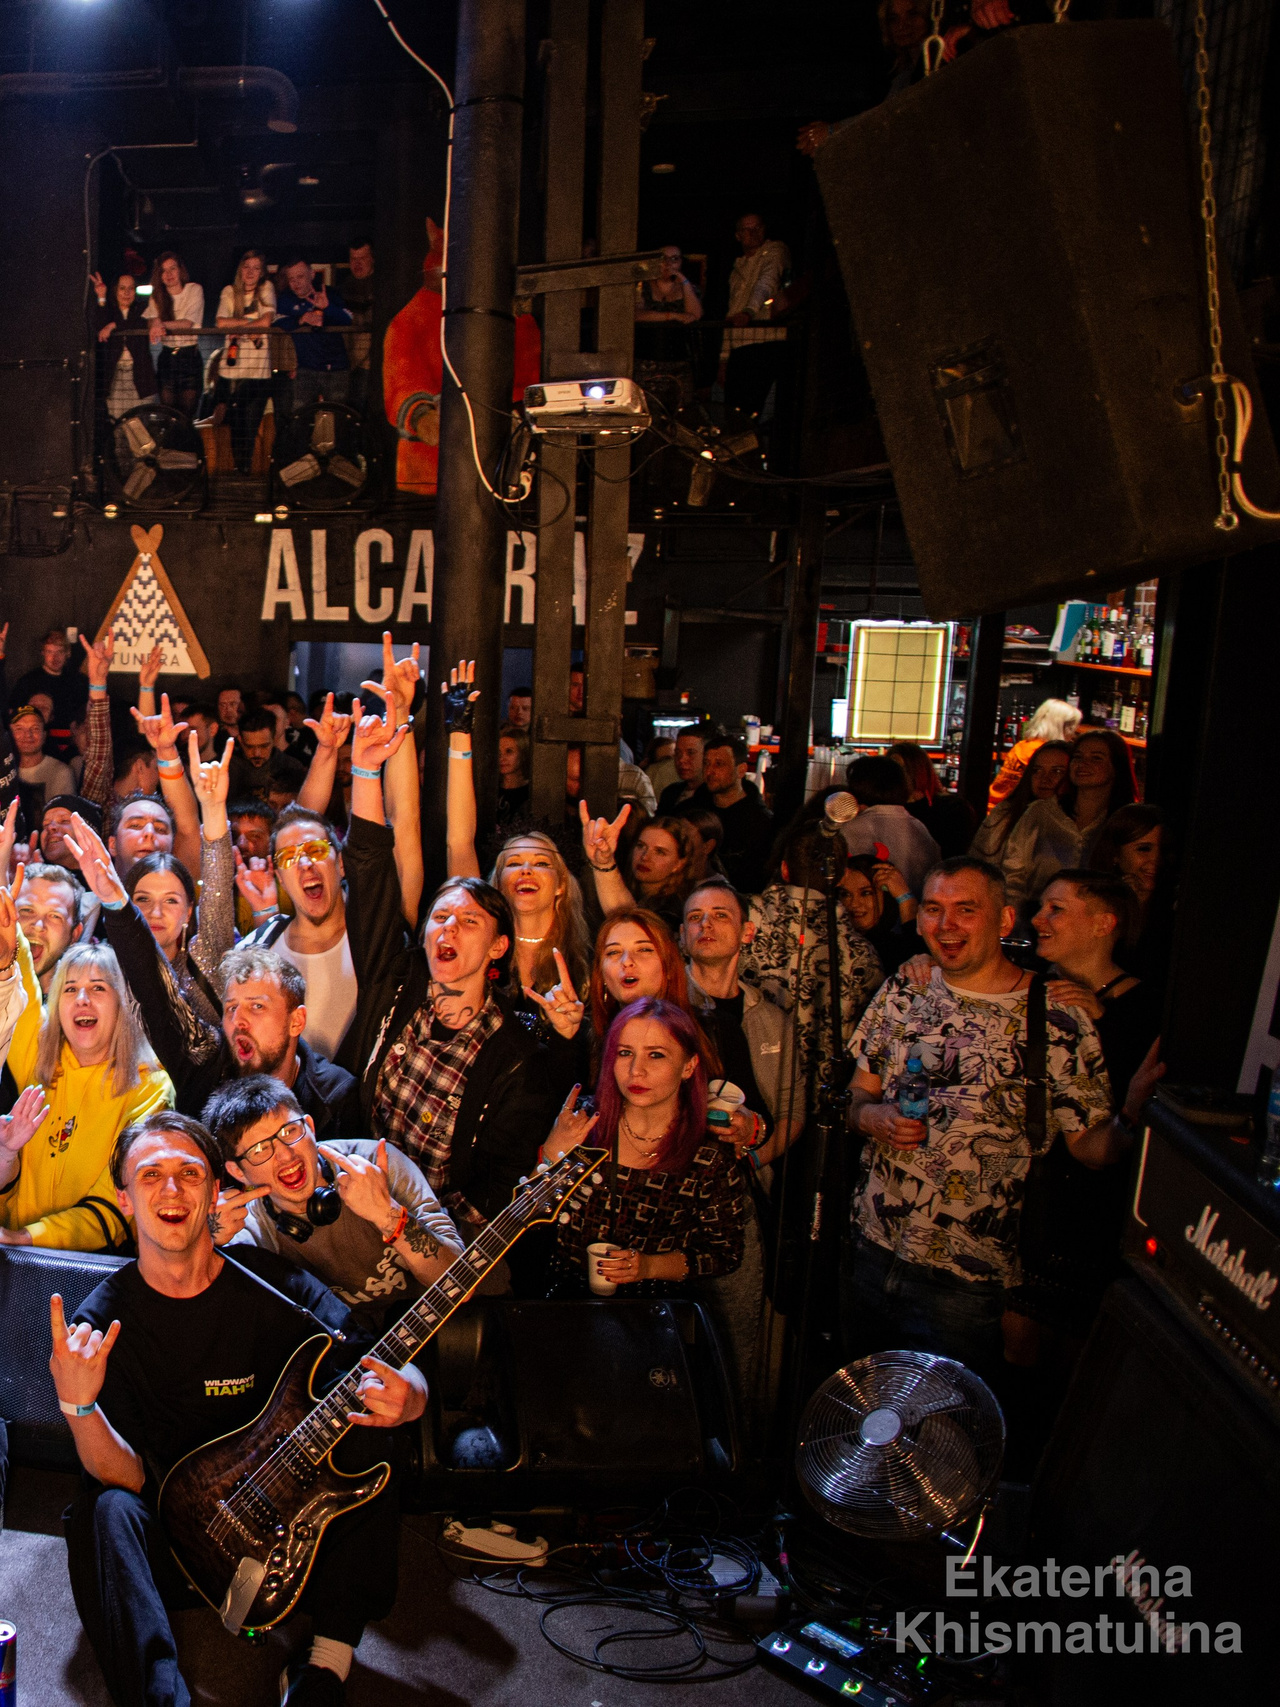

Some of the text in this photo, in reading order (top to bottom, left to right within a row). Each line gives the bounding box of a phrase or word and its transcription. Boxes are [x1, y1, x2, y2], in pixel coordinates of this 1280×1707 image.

[112, 651, 180, 667] TUNRA
[1184, 1203, 1279, 1311] Marshall
[204, 1373, 255, 1387] WILDWAYS
